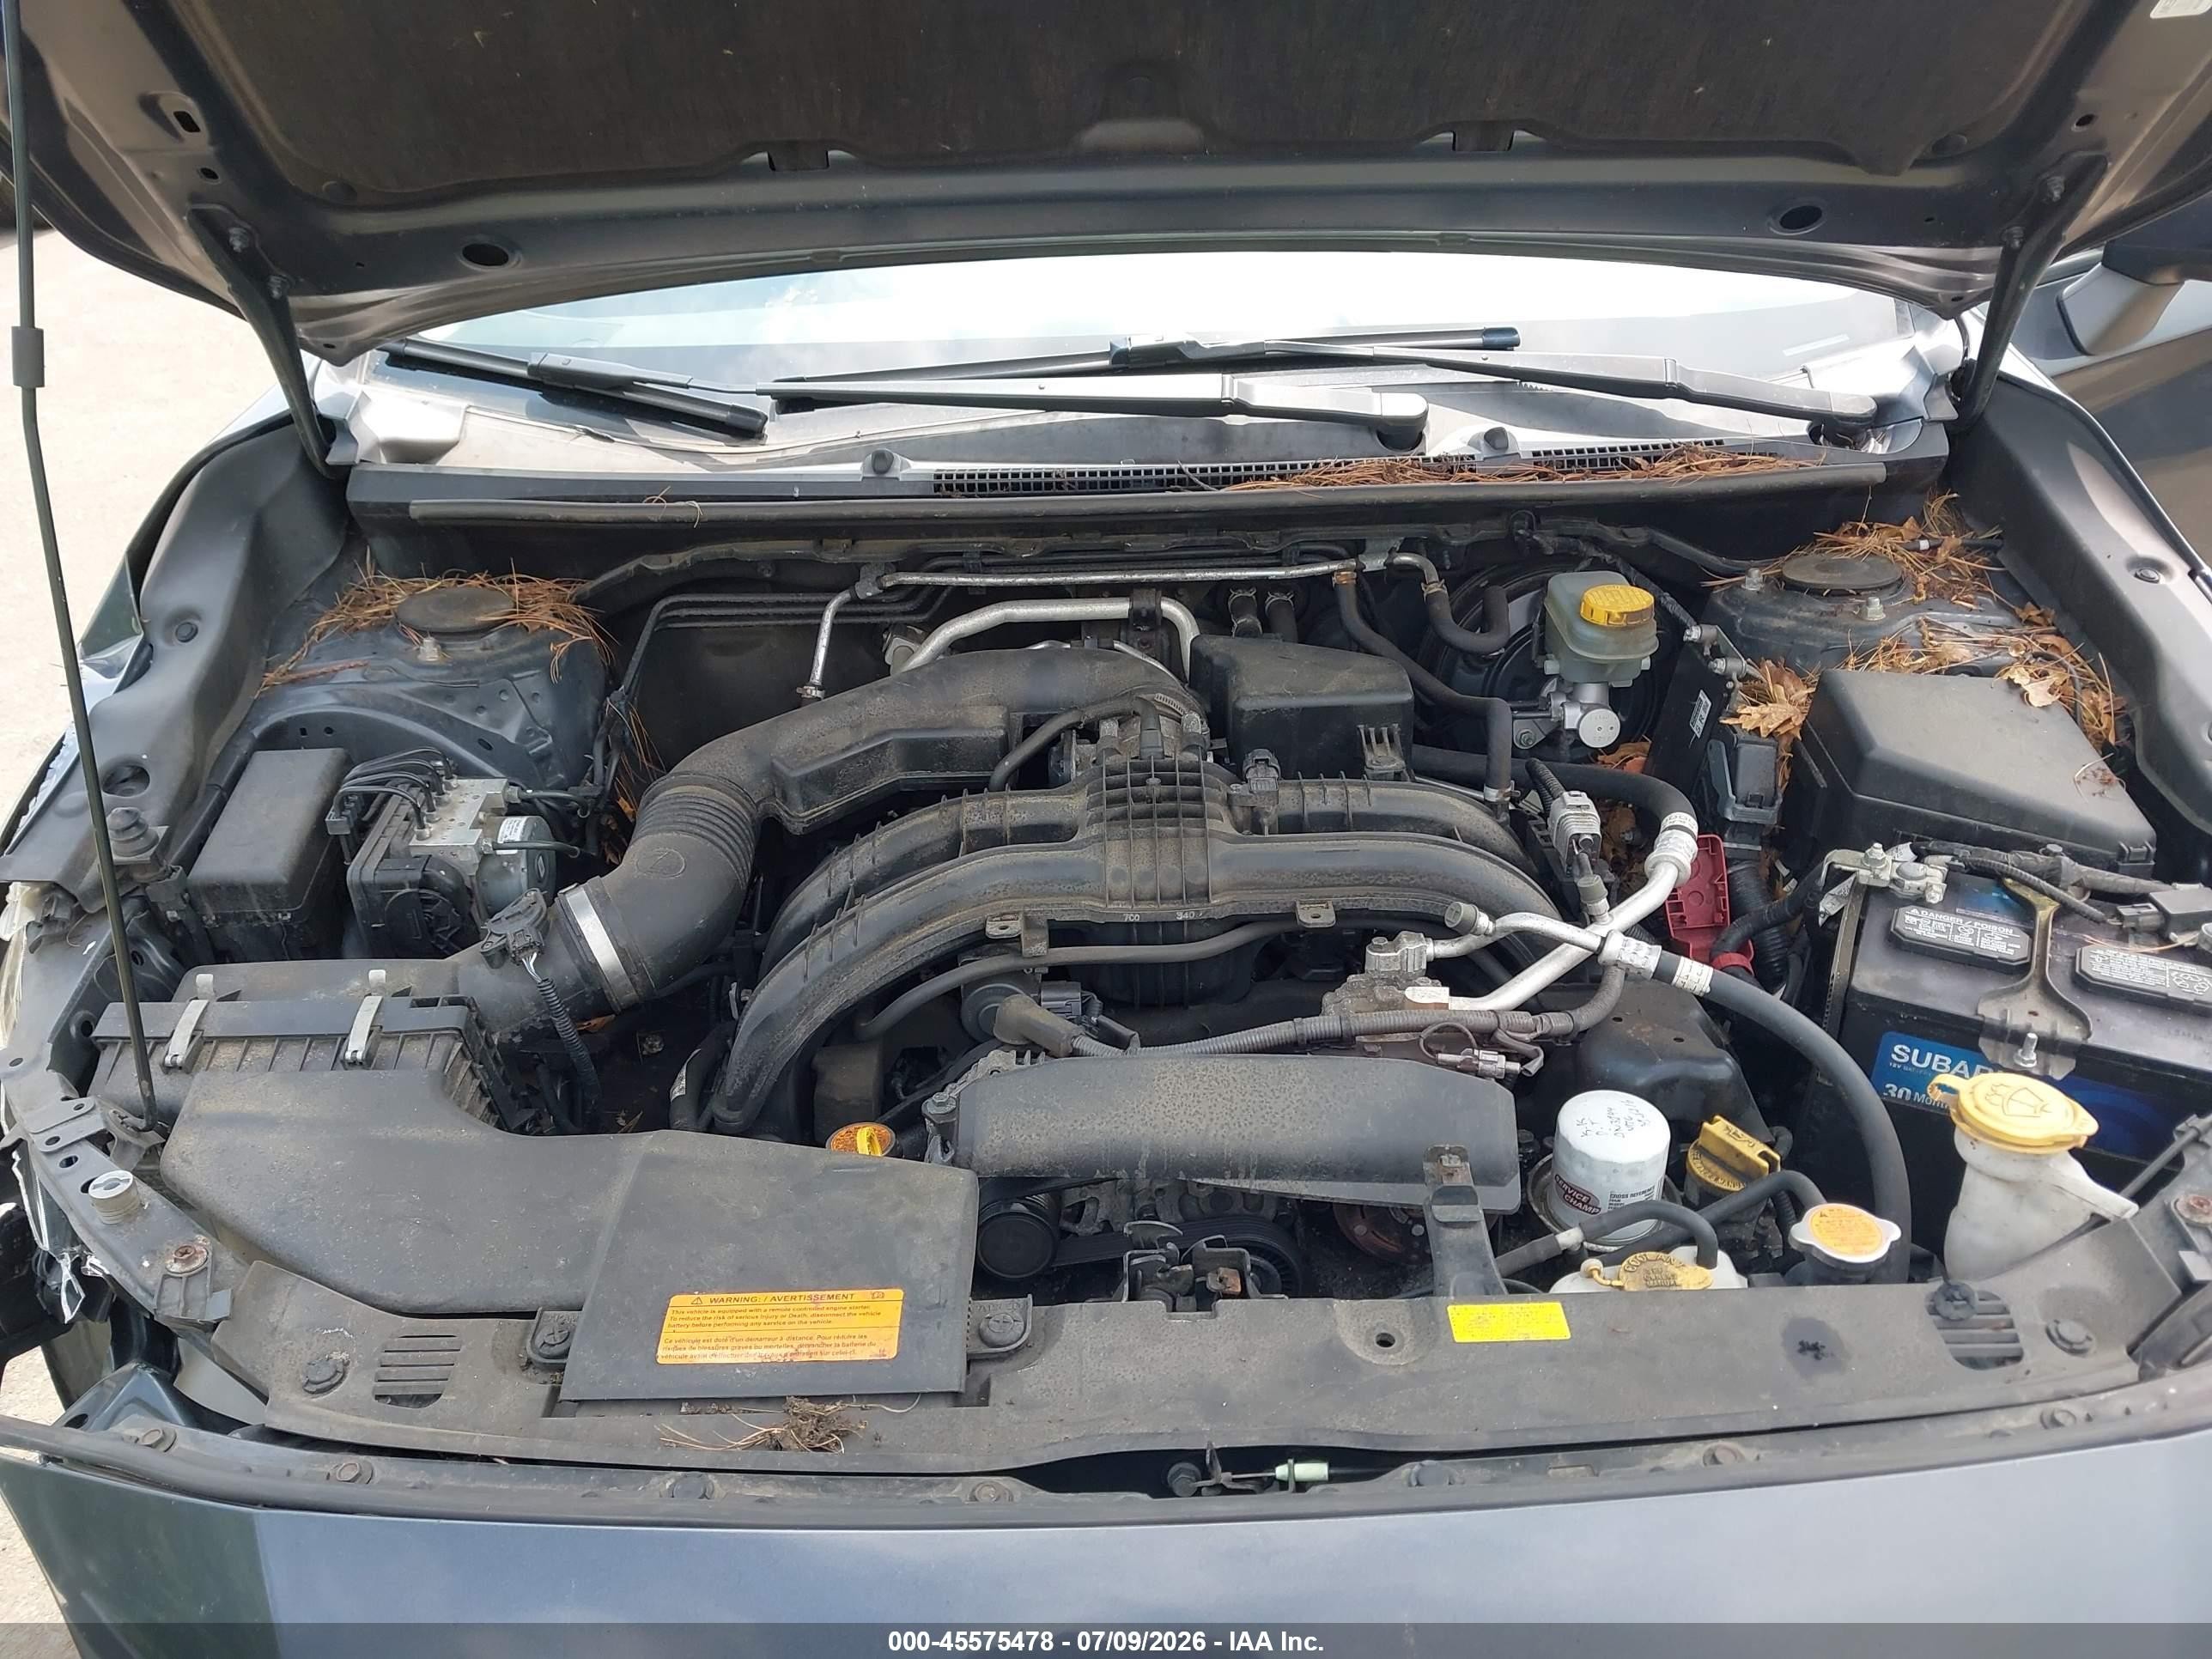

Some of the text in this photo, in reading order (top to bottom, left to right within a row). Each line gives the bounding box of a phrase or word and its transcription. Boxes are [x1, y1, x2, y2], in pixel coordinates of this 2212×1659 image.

[1920, 909, 1964, 925] DANGER
[1974, 921, 2014, 934] POISON
[1891, 1044, 1996, 1079] SUBAR
[1883, 1084, 1911, 1101] 30
[1555, 1174, 1590, 1203] SERVICE
[1564, 1193, 1601, 1214] CHAMP
[709, 1296, 762, 1304] WARNING:
[769, 1292, 855, 1303] AVERTISSEMENT
